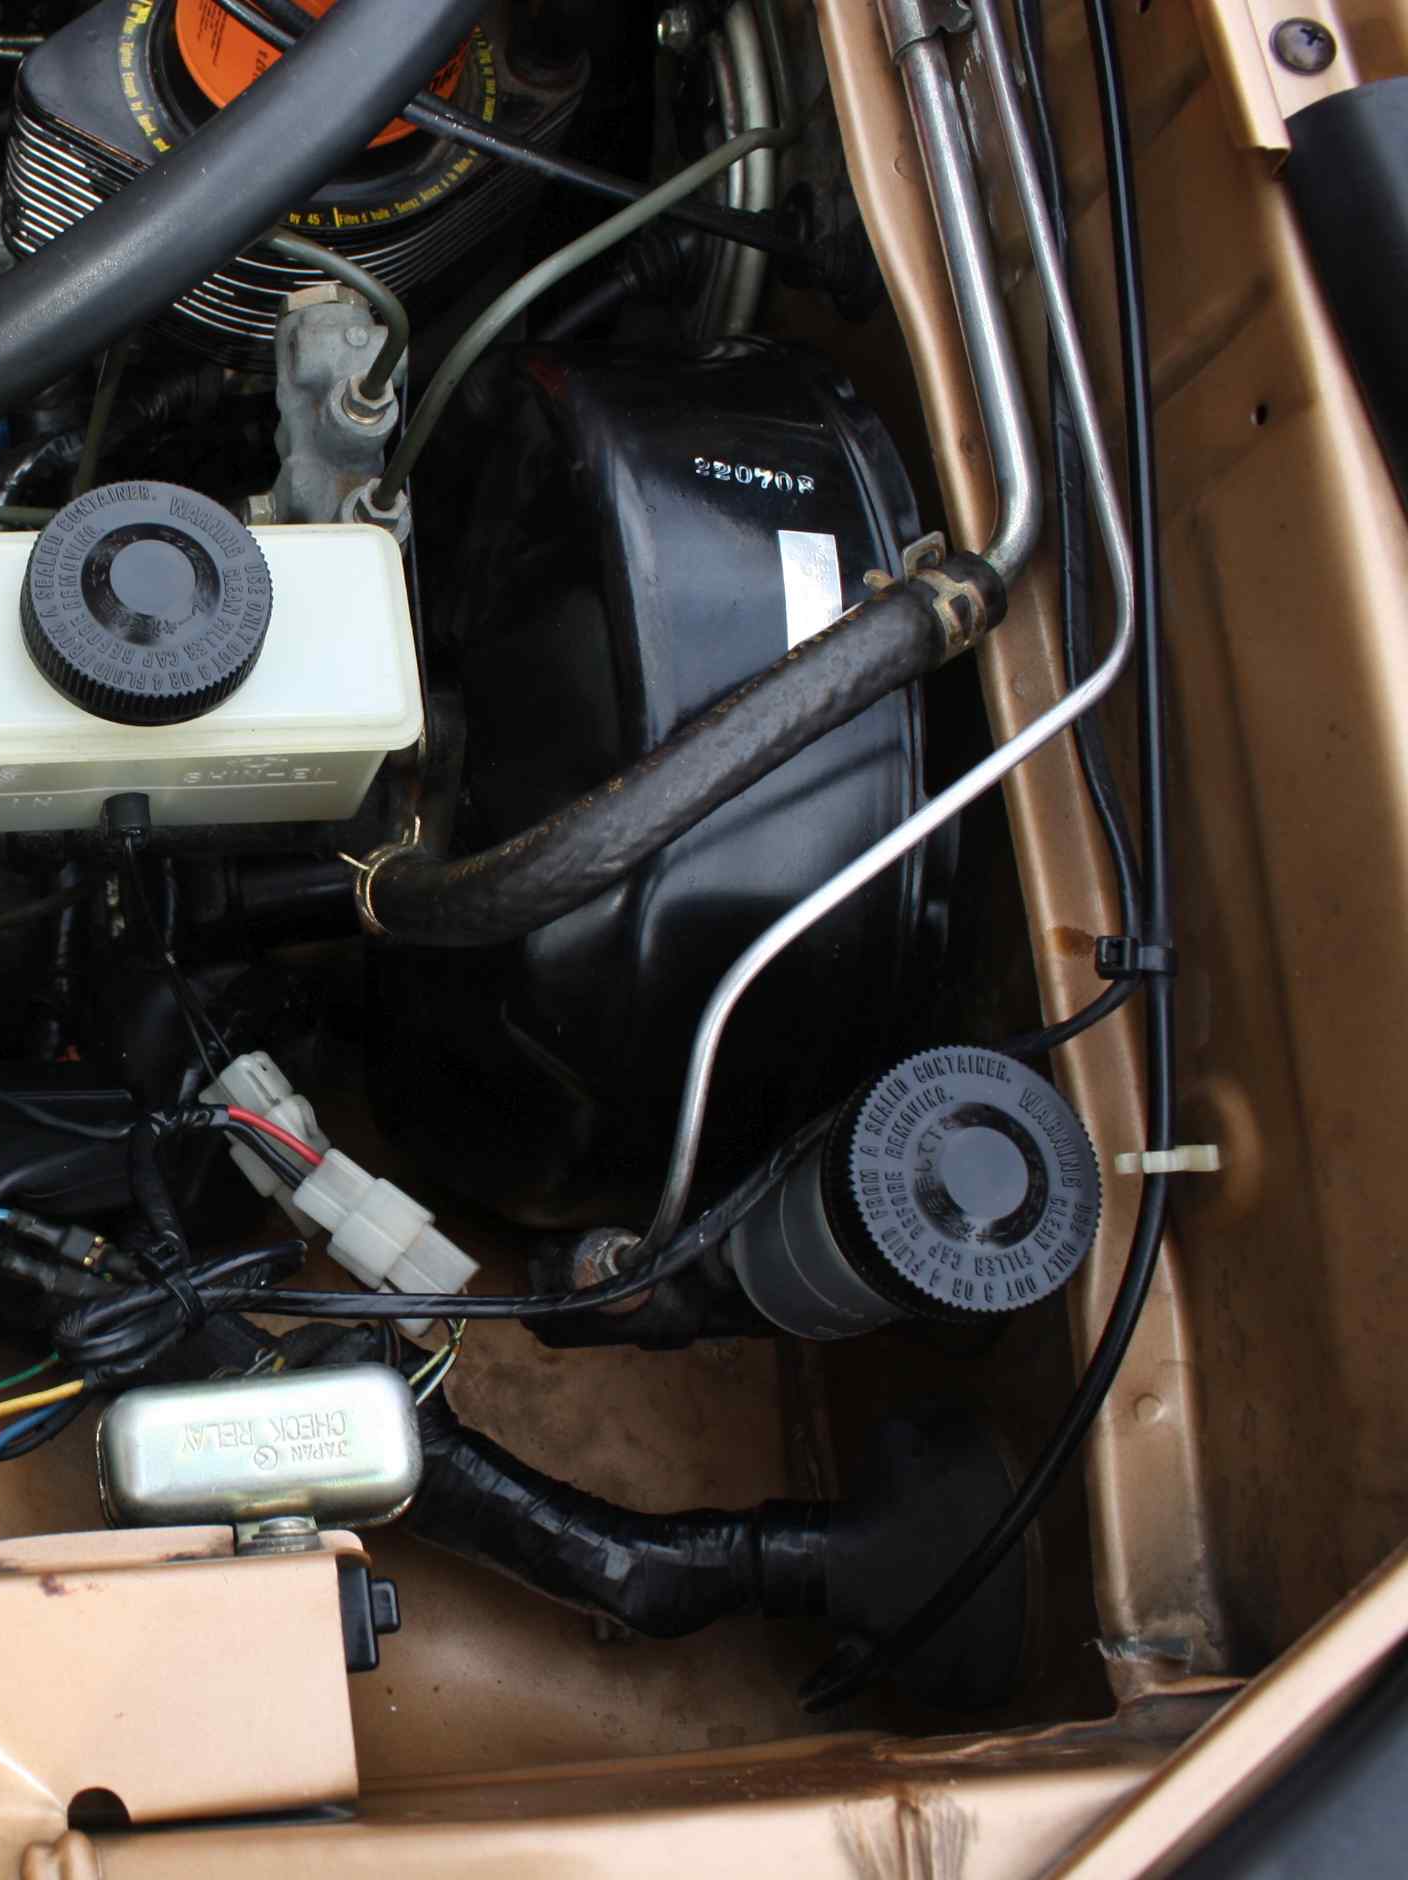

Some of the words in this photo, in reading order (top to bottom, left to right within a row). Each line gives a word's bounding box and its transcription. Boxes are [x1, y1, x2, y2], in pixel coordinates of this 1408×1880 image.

[56, 484, 158, 533] CONTAINER.
[168, 496, 244, 560] WARNING
[34, 532, 61, 601] SEALED
[244, 562, 267, 597] USE
[222, 565, 243, 616] CLEAN
[40, 606, 58, 620] A
[242, 600, 265, 646] ONLY
[49, 621, 88, 668] FROM
[69, 612, 138, 666] BEFORE
[183, 616, 235, 660] FILLER
[92, 661, 146, 690] FLUID
[142, 650, 180, 668] CAP
[213, 642, 242, 676] DOT
[168, 672, 194, 689] OR
[912, 1054, 1012, 1084] CONTAINER.
[864, 1076, 910, 1136] SEALED
[883, 1084, 955, 1160] REMOVING.
[860, 1144, 880, 1159] A
[1018, 1088, 1083, 1190] WARNING
[861, 1168, 888, 1220] FROM
[886, 1170, 922, 1240] BEFORE
[1037, 1194, 1068, 1252] CLEAN
[1069, 1202, 1094, 1237] USE
[881, 1228, 928, 1277] FLUID
[928, 1241, 962, 1270] CAP
[974, 1249, 1035, 1278] FILLER
[1042, 1241, 1078, 1281] ONLY
[928, 1270, 942, 1288] 4
[952, 1278, 975, 1302] OR
[984, 1284, 994, 1302] 3
[1006, 1277, 1038, 1300] DOT
[180, 1420, 255, 1453] RELAY
[269, 1410, 347, 1443] CHECK
[289, 1440, 349, 1463] JAPAN
